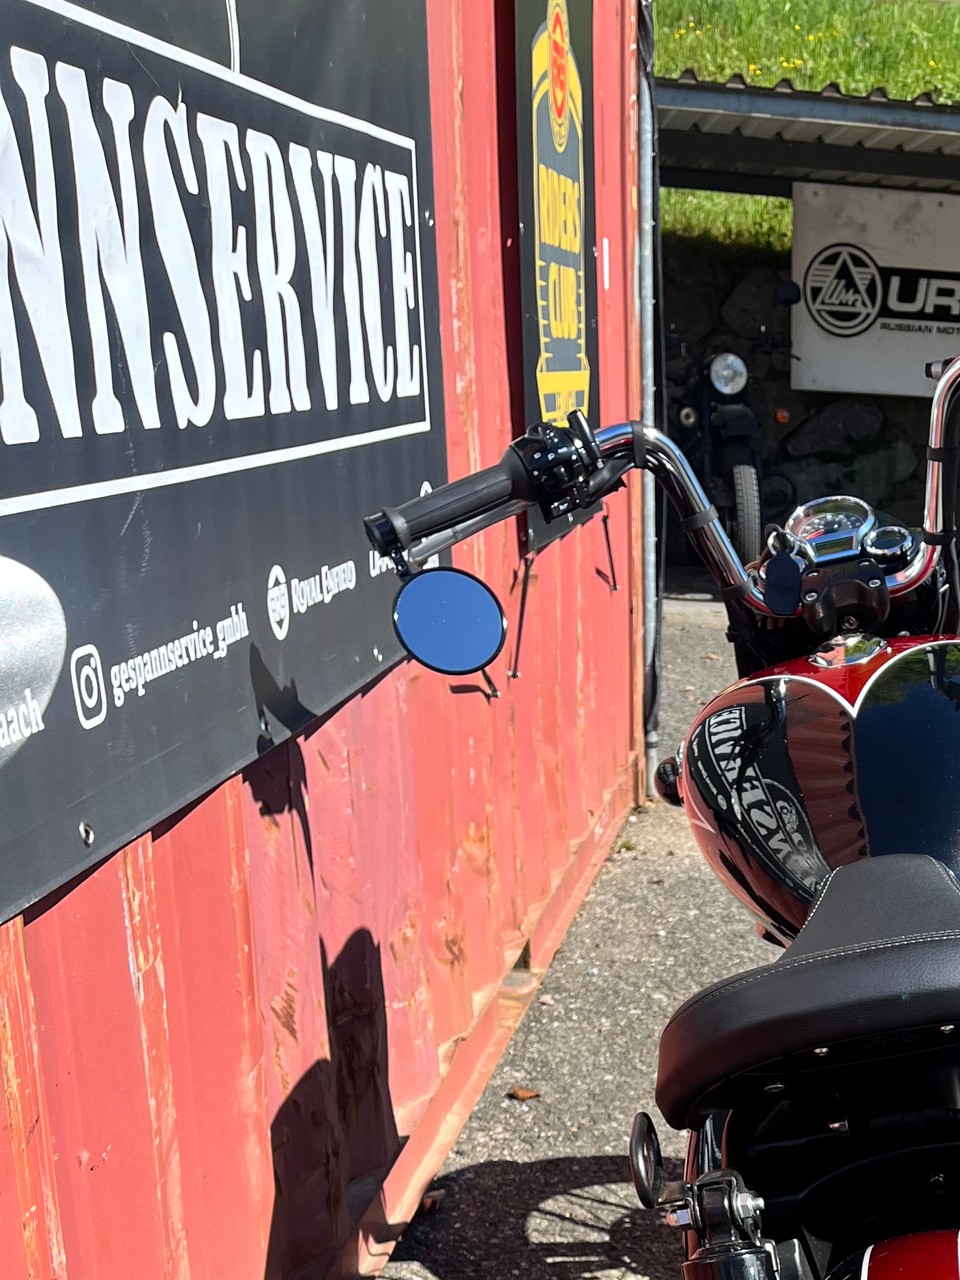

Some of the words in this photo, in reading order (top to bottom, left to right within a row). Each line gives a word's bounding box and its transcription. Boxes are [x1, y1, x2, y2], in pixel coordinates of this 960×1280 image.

[538, 163, 581, 255] RIDERS
[548, 261, 578, 340] CLUB
[110, 602, 249, 707] gespannservice_gmbh
